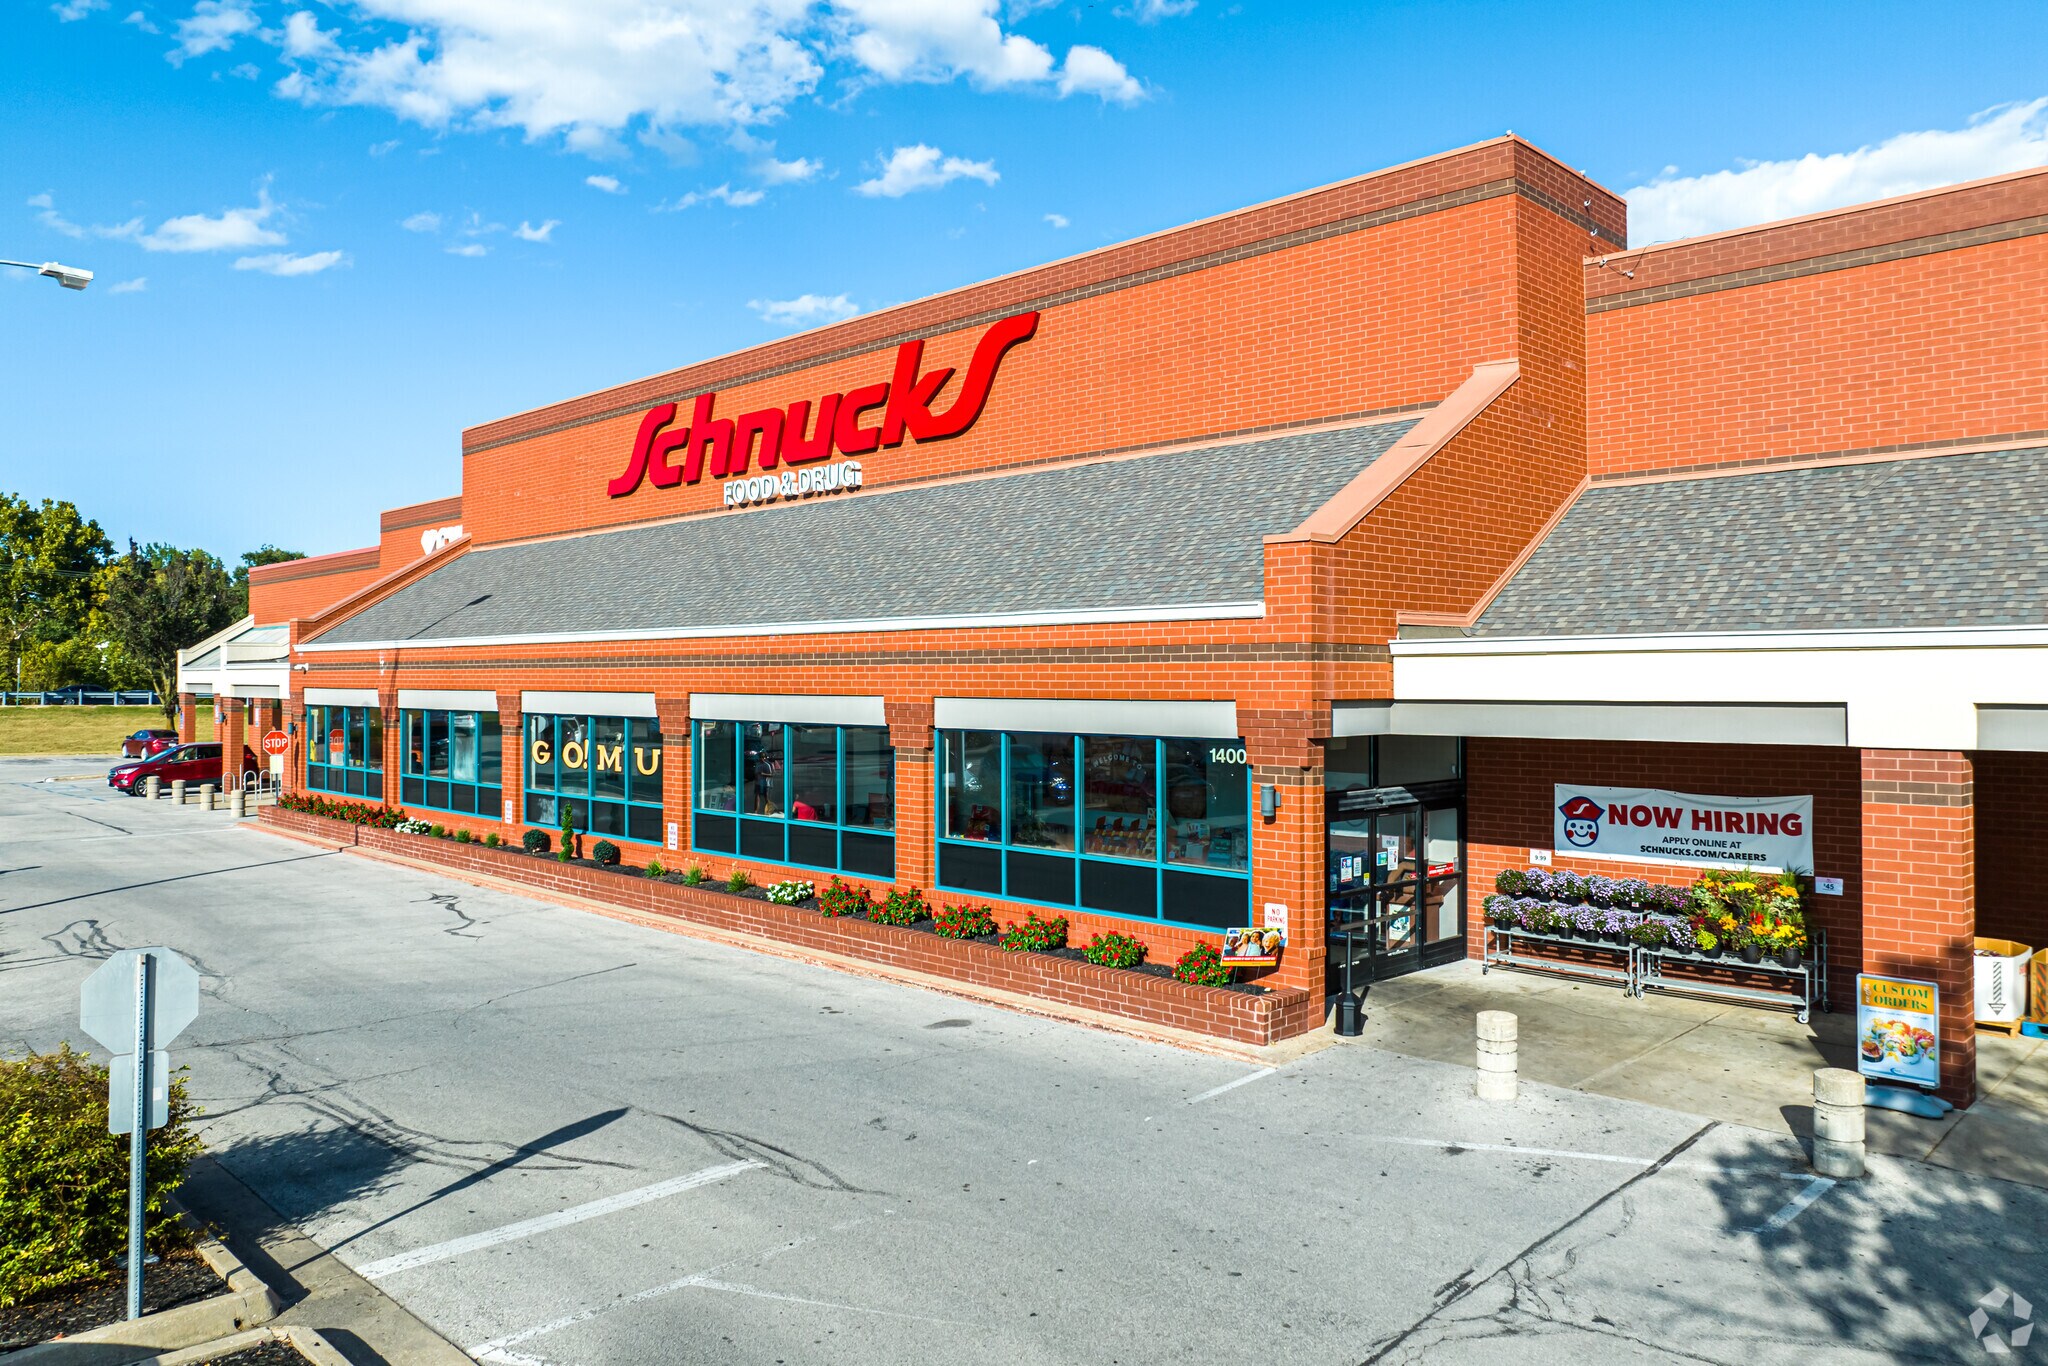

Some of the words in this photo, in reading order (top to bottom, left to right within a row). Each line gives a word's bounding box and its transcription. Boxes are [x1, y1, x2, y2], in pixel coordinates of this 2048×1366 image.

[607, 310, 1041, 497] Schnucks
[723, 475, 780, 505] FOOD
[780, 471, 799, 496] &
[798, 460, 862, 494] DRUG
[265, 738, 288, 748] STOP
[1092, 754, 1130, 768] WELCOME
[1133, 760, 1142, 769] TO
[1209, 748, 1247, 764] 1400
[1608, 803, 1683, 829] NOW
[1691, 809, 1802, 836] HIRING
[1662, 836, 1690, 845] APPLY
[1692, 839, 1727, 848] ONLINE
[1729, 841, 1742, 849] AT
[1640, 845, 1767, 861] SCHNUCKS.COM/CAREERS
[1271, 908, 1281, 916] NO
[1267, 915, 1285, 925] PARKING
[1873, 983, 1928, 999] CUSTOM
[1874, 995, 1928, 1010] ORDERS
